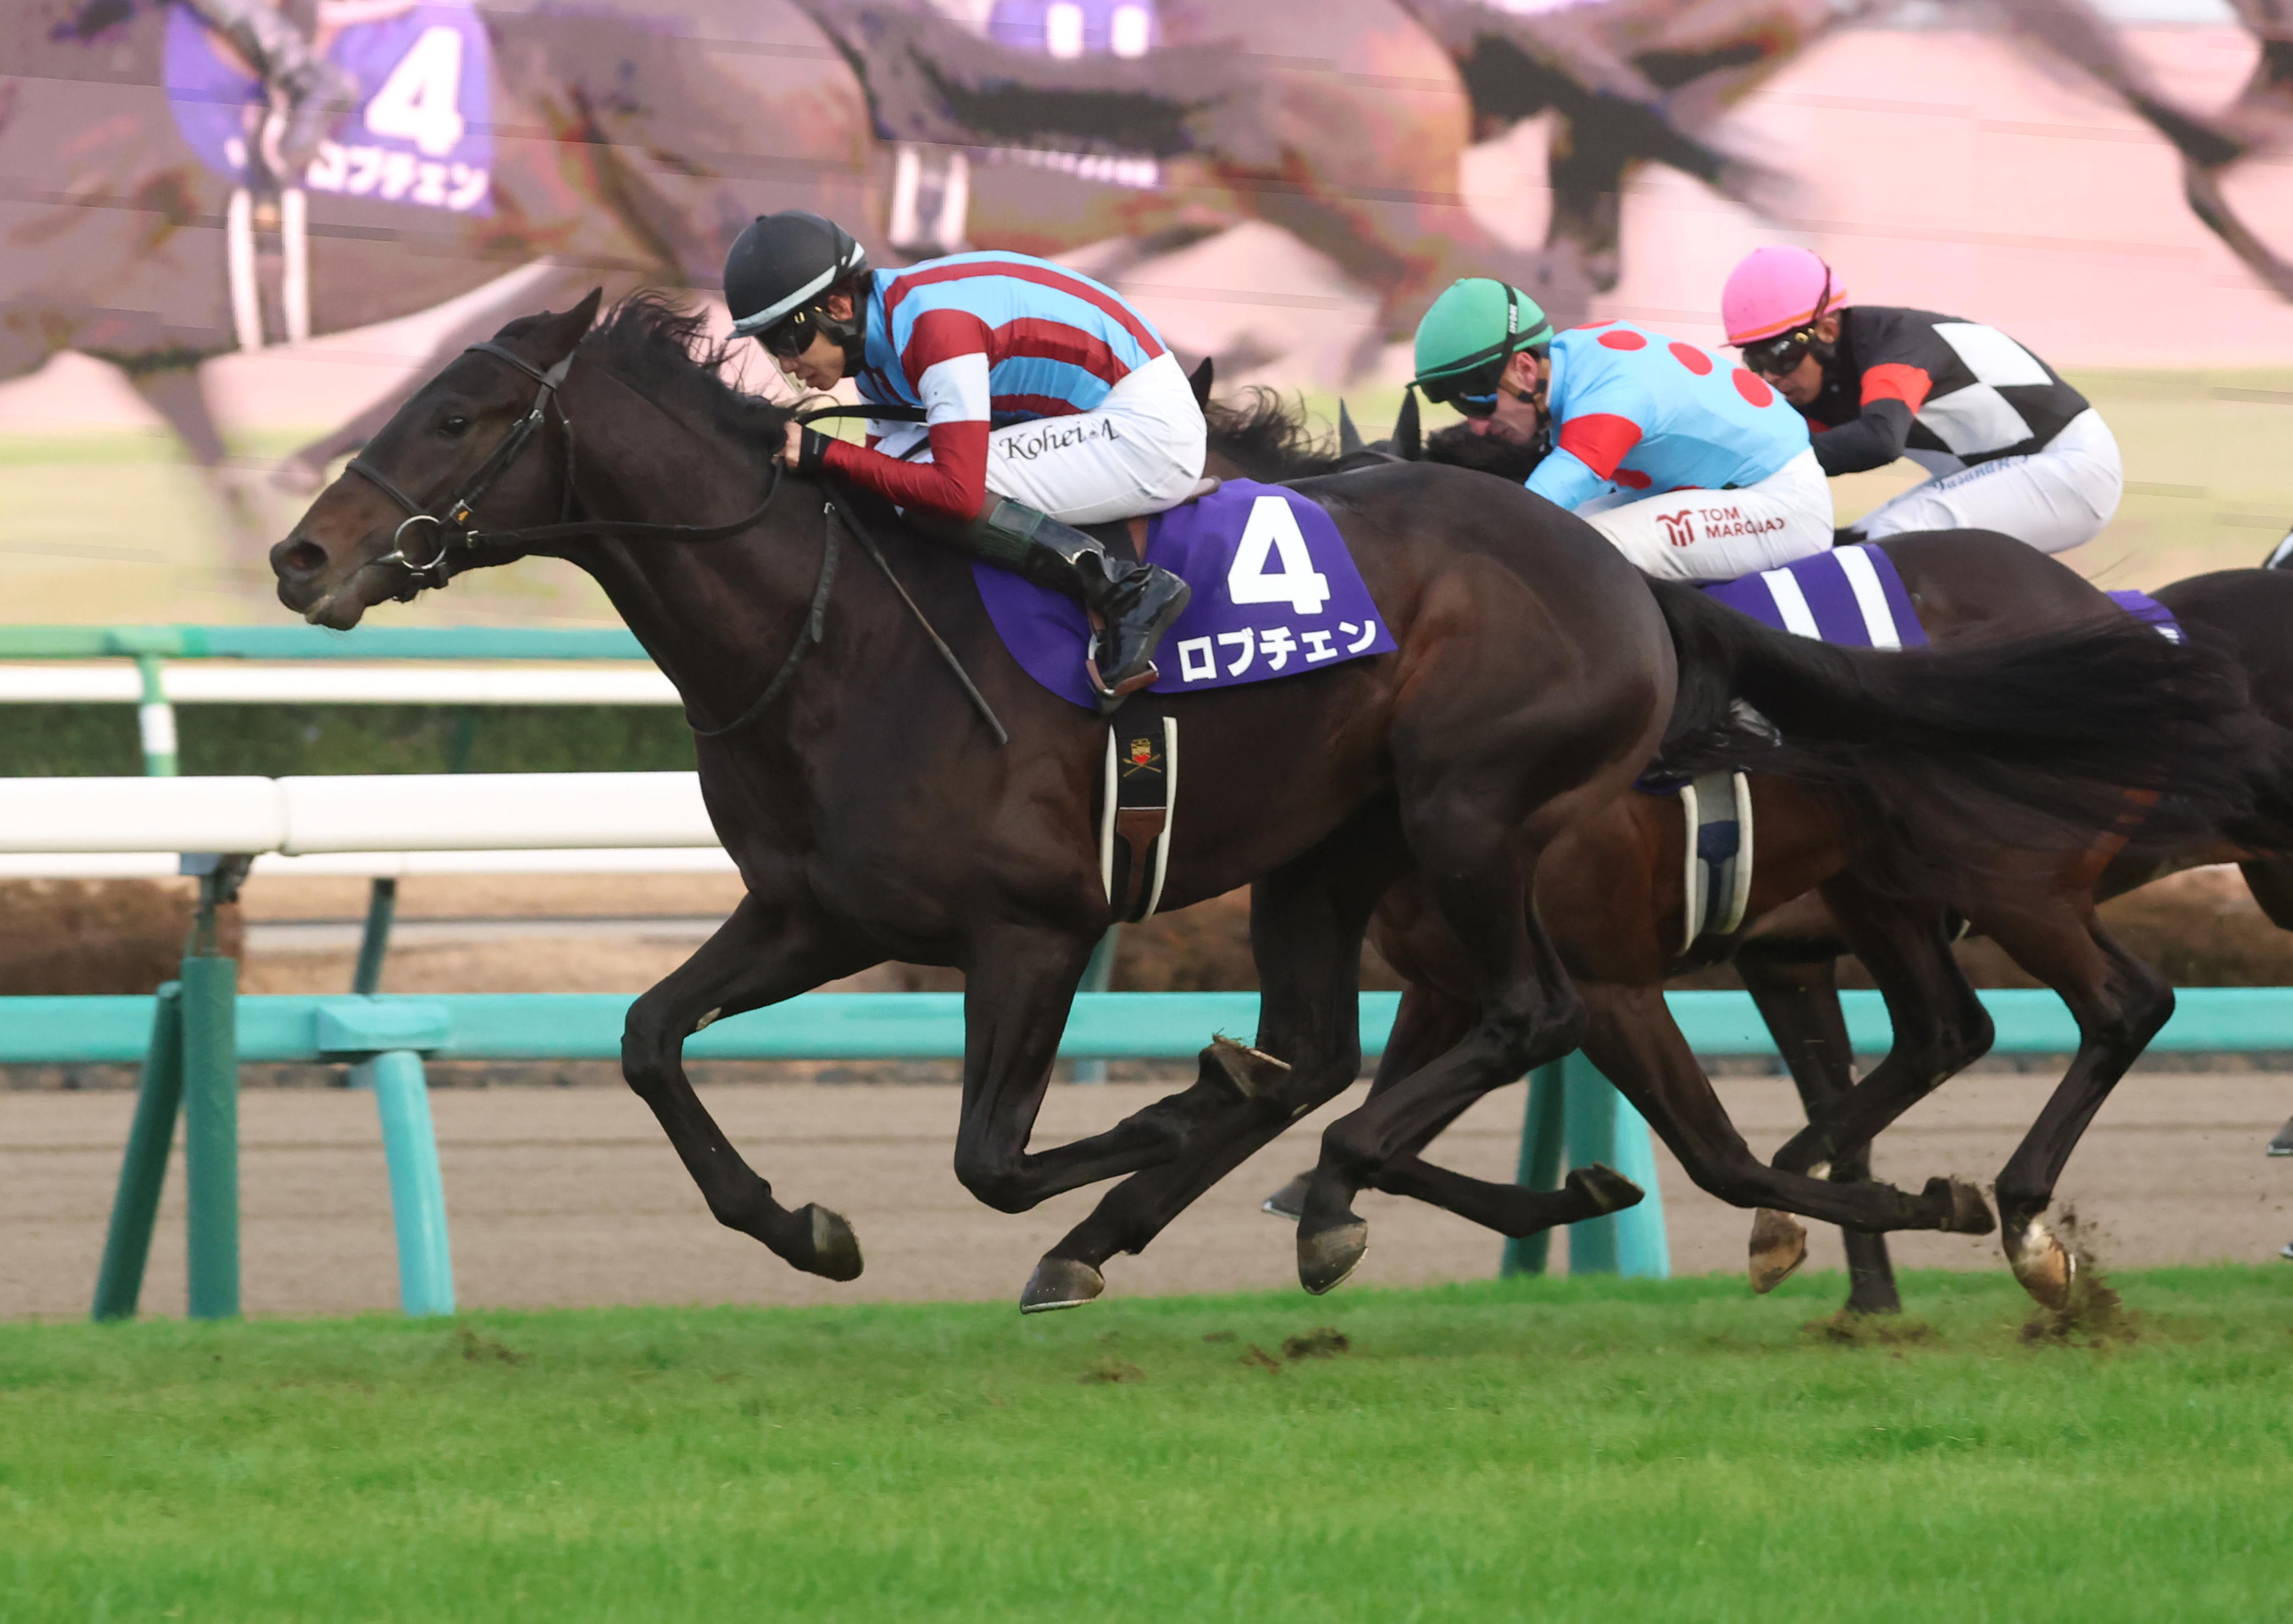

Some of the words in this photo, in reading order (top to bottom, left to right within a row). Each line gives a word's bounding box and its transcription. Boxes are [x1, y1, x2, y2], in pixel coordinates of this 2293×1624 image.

[364, 25, 463, 156] 4
[1227, 495, 1331, 615] 4
[1698, 506, 1740, 522] TOM
[1177, 620, 1376, 682] ロブチェン
